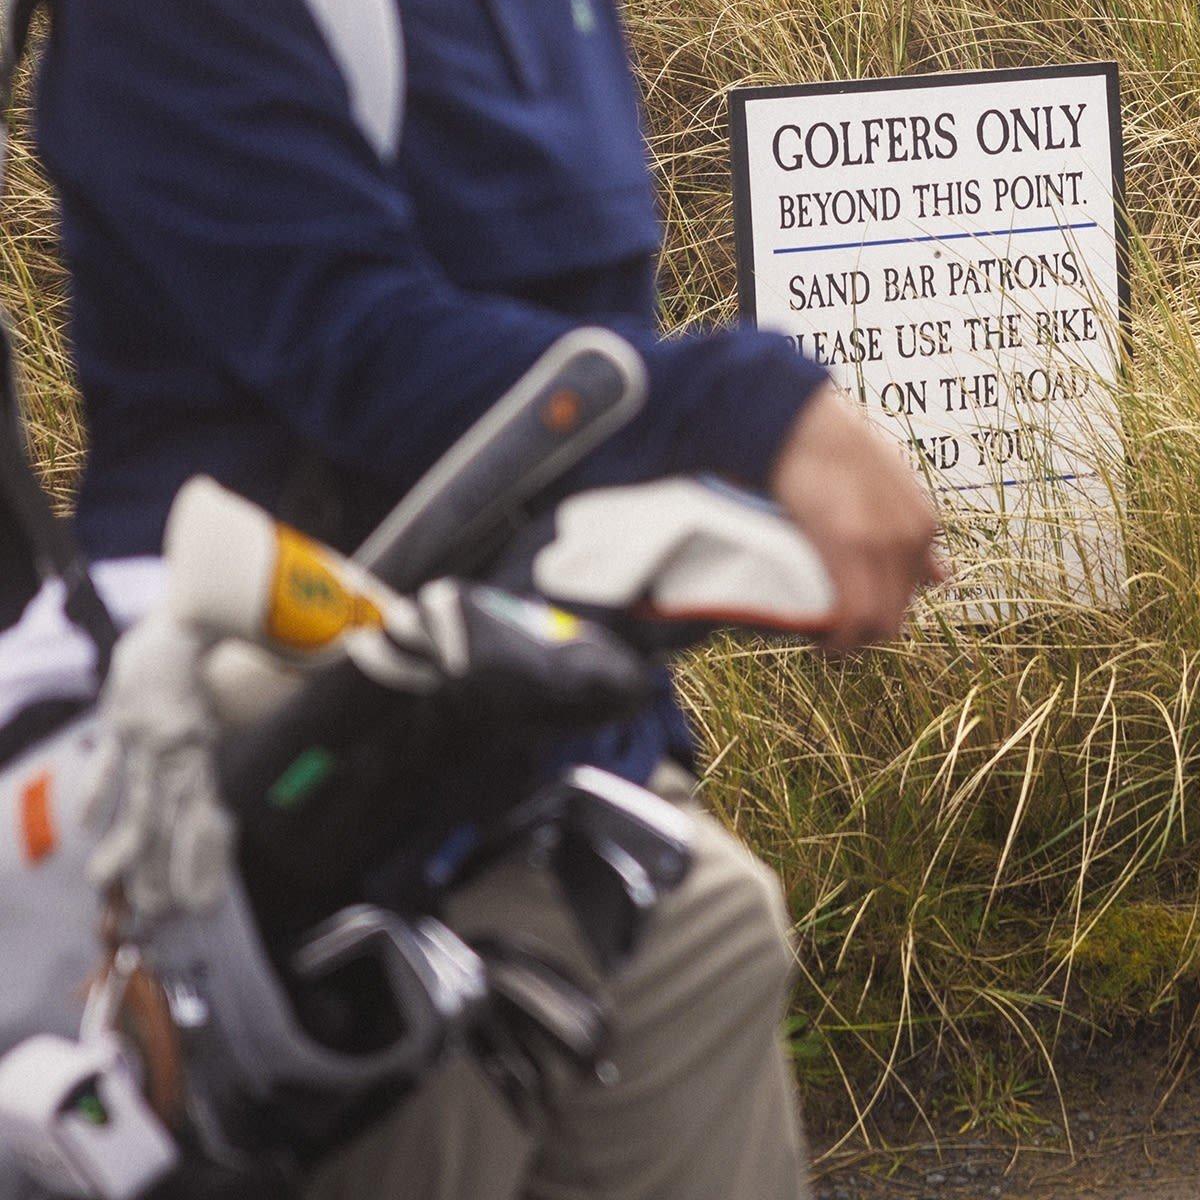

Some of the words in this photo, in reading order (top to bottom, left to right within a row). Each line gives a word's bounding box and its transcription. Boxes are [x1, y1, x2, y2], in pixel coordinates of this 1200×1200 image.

[772, 112, 957, 171] GOLFERS
[976, 103, 1087, 155] ONLY
[779, 187, 901, 229] BEYOND
[912, 180, 982, 218] THIS
[994, 171, 1087, 211] POINT.
[788, 270, 870, 310] SAND
[884, 264, 936, 301] BAR
[947, 252, 1086, 295] PATRONS,
[894, 321, 953, 358] USE
[963, 313, 1023, 352] THE
[1035, 307, 1097, 346] BIKE
[880, 379, 927, 418] ON
[939, 373, 999, 411] THE
[1013, 368, 1090, 405] ROAD
